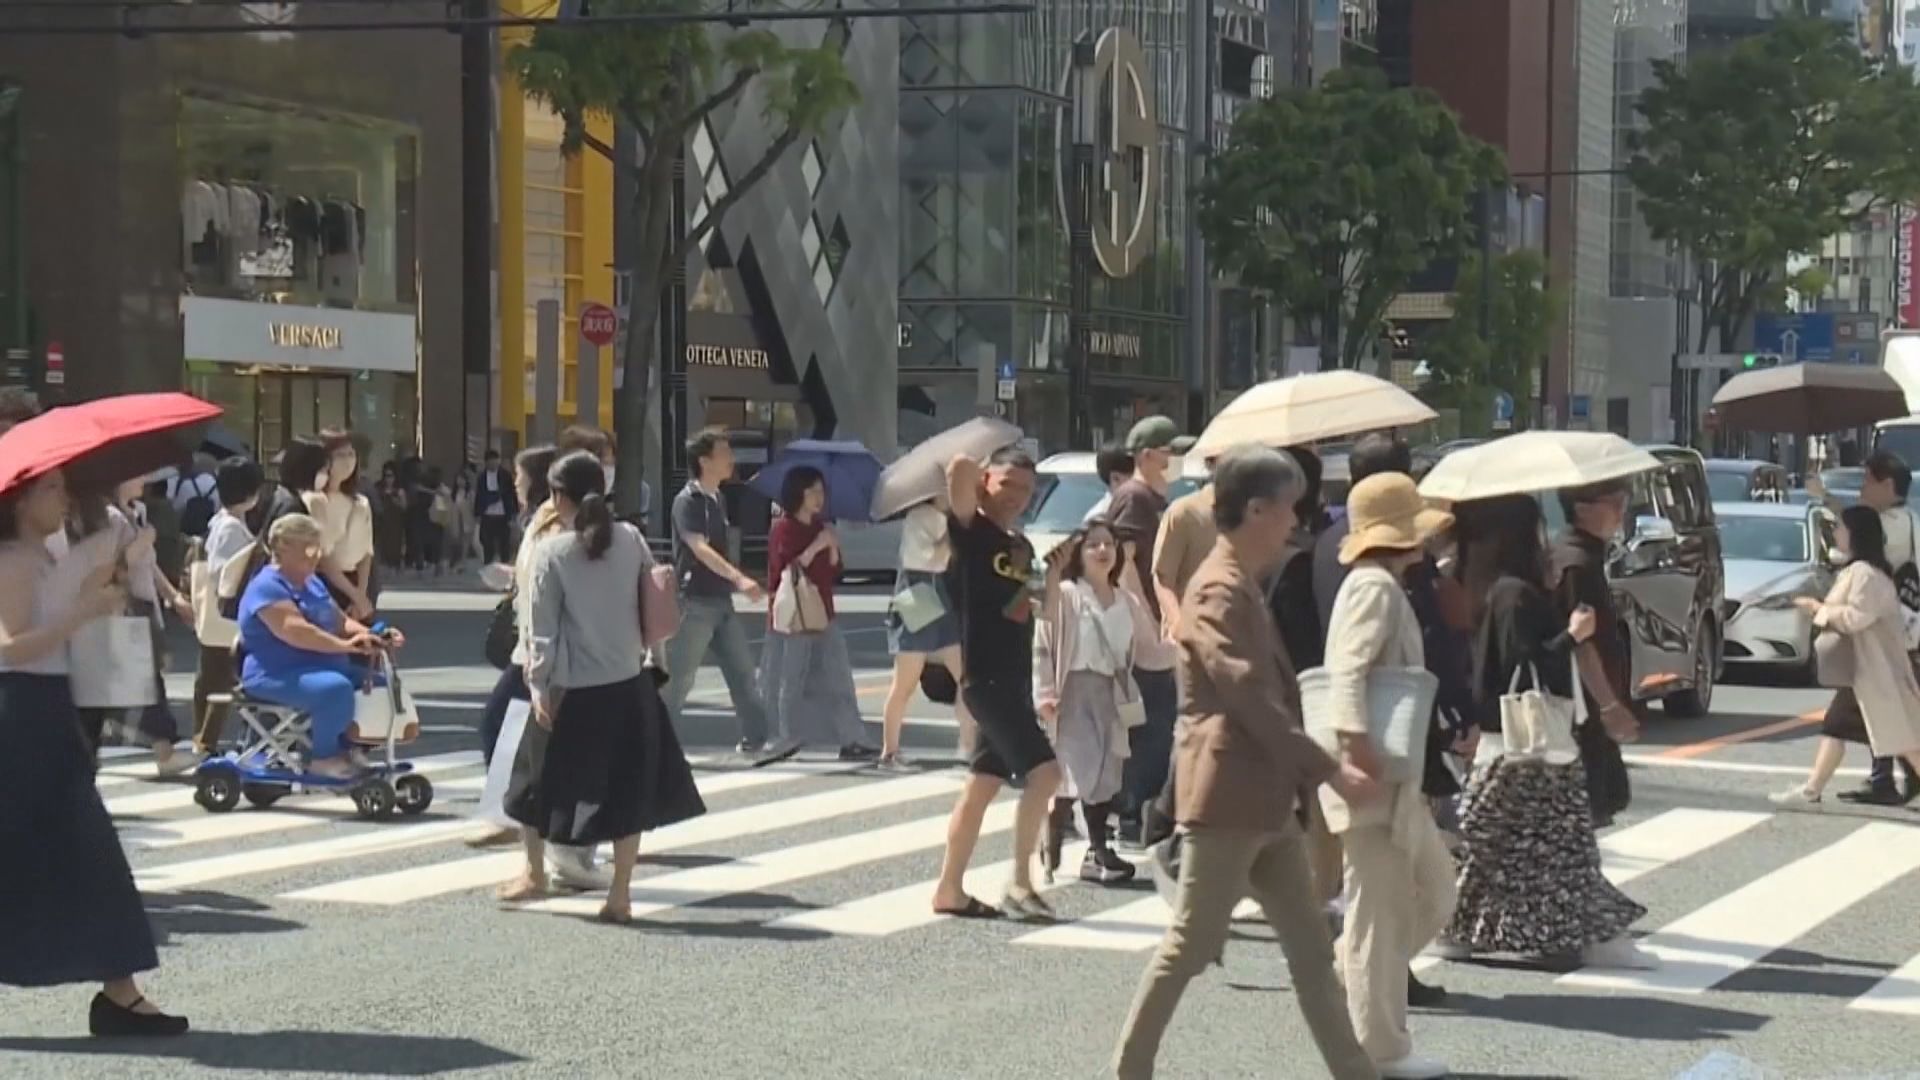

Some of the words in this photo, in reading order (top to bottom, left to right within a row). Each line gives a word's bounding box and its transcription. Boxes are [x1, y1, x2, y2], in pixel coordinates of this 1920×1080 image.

[898, 322, 912, 347] E
[686, 343, 728, 366] OTTEGA
[729, 347, 769, 368] VENETA
